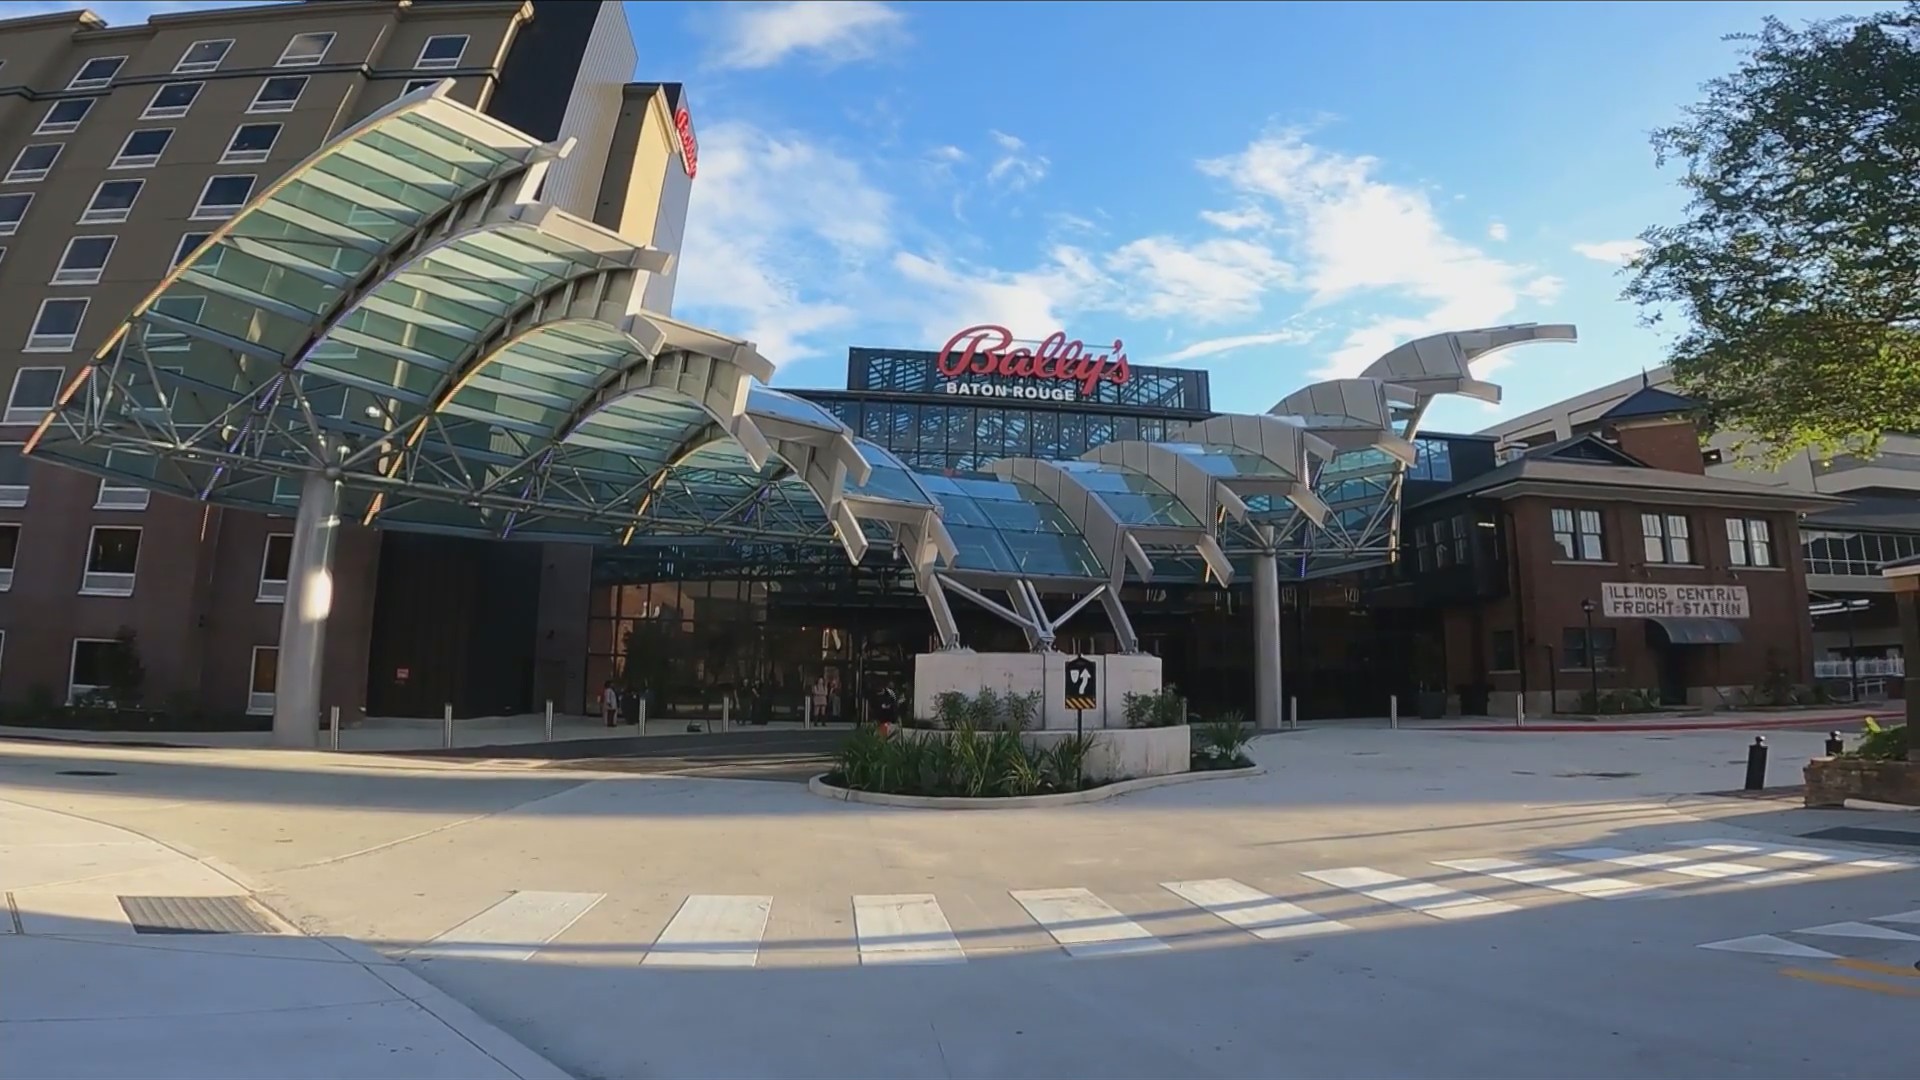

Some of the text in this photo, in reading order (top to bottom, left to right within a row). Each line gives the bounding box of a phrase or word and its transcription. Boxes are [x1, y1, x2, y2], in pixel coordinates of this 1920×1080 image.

[938, 325, 1131, 395] Bally's
[947, 382, 1075, 401] BATON ROUGE
[1609, 586, 1741, 602] ILLINOIS CENTRAL
[1613, 601, 1674, 614] FREIGHT
